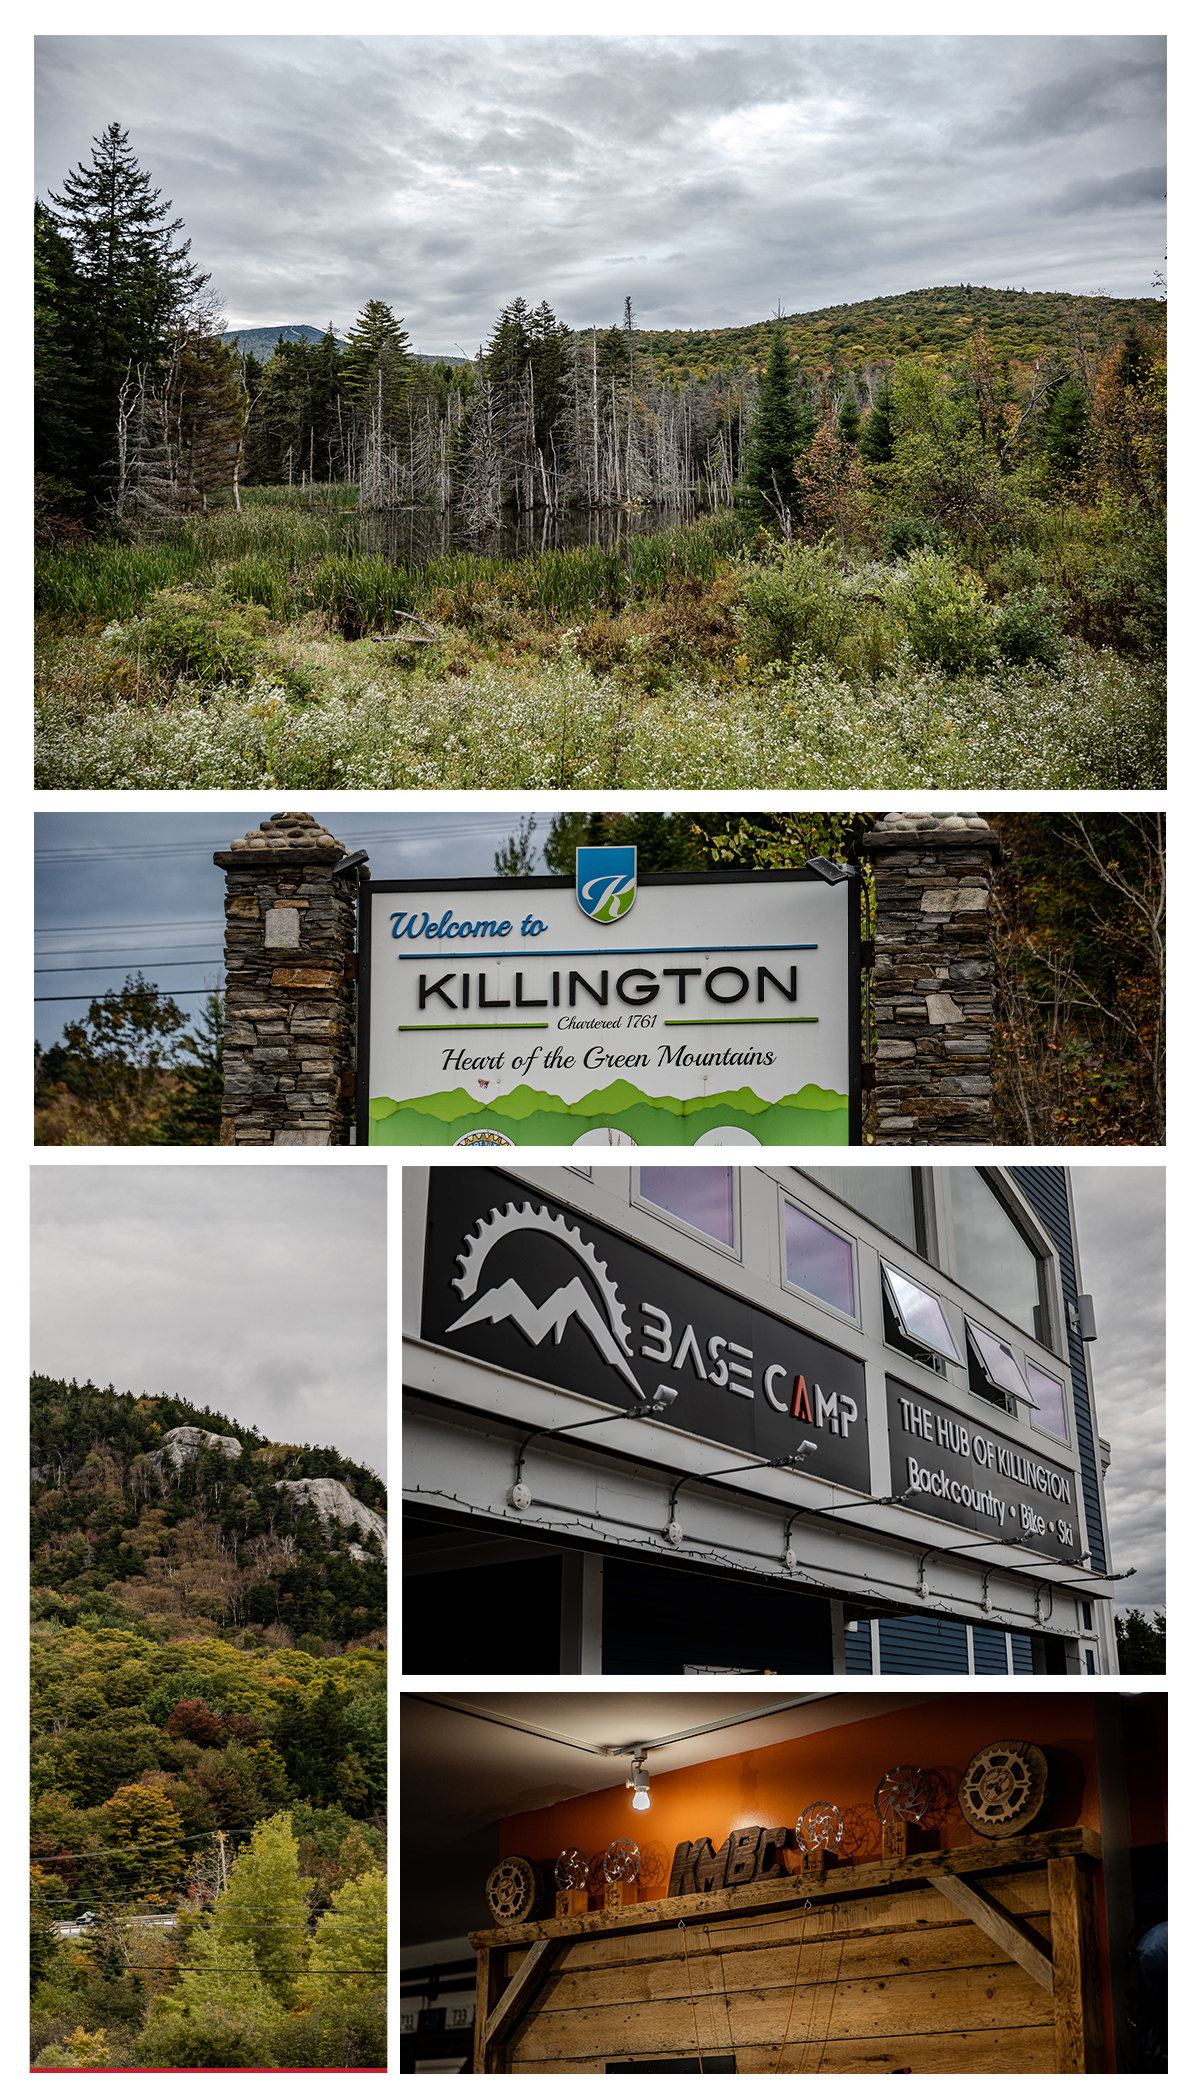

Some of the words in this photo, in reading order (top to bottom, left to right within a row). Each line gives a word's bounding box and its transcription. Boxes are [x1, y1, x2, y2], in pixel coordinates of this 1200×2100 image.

[390, 909, 513, 939] Welcome
[520, 914, 549, 937] to
[418, 965, 798, 1009] KILLINGTON
[557, 1015, 622, 1031] Chartered
[626, 1014, 658, 1029] 1761
[442, 1048, 505, 1071] Heart
[511, 1046, 543, 1077] of
[543, 1045, 576, 1070] the
[583, 1045, 651, 1070] Green
[657, 1044, 777, 1067] Mountains
[641, 1302, 755, 1399] BASE
[764, 1363, 858, 1438] CAMP
[899, 1397, 934, 1442] THE
[935, 1415, 970, 1457] HUB
[972, 1435, 995, 1469] OF
[996, 1445, 1071, 1504] KILLINGTON
[907, 1456, 1005, 1526] Backcountry
[1019, 1503, 1046, 1536] Bike
[1057, 1518, 1074, 1547] Ski
[668, 1825, 789, 1898] KMBC
